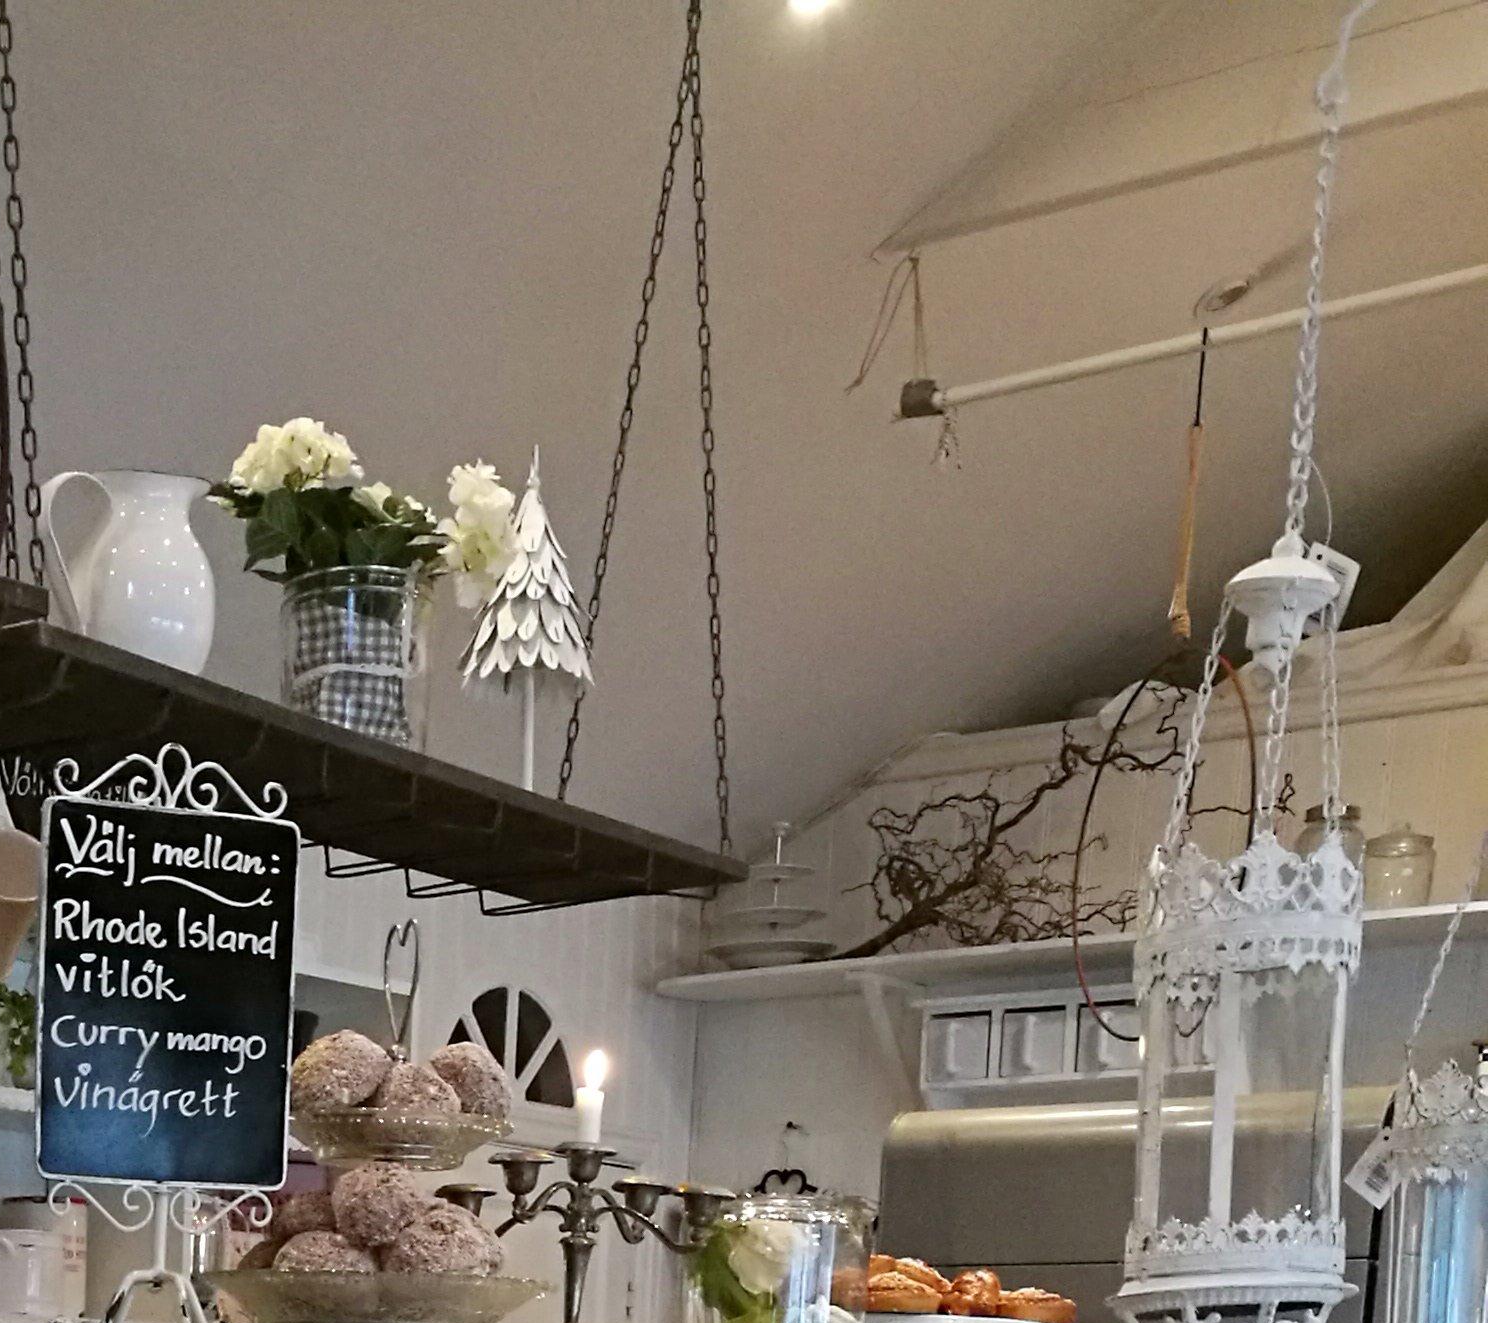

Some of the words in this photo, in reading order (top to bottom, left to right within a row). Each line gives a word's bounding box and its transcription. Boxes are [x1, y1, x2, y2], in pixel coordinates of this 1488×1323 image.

[60, 814, 136, 887] Välj
[151, 833, 281, 876] mellan:
[53, 898, 167, 949] Rhode
[178, 907, 279, 960] Island
[55, 953, 187, 1003] vitlök
[50, 1015, 160, 1070] Curry
[166, 1031, 267, 1075] mango
